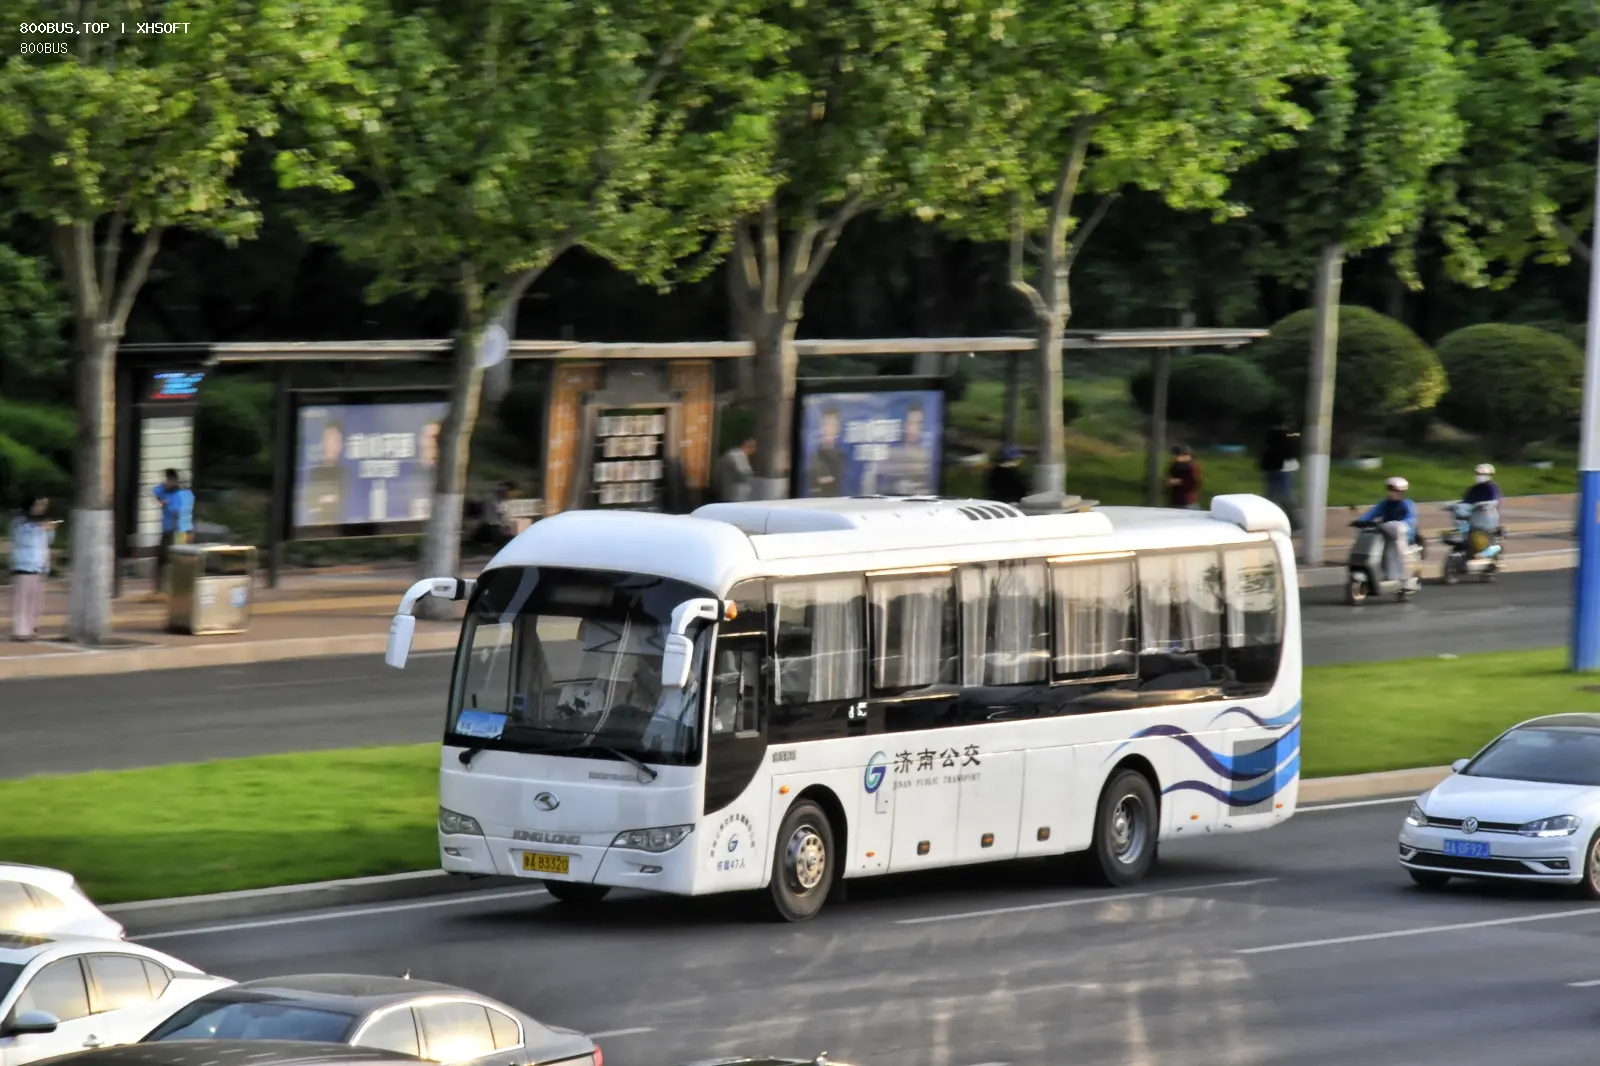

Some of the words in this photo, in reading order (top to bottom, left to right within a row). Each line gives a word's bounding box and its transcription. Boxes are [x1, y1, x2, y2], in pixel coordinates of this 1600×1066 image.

[894, 744, 981, 774] 济南公交
[916, 777, 939, 787] PUBLIC
[943, 772, 981, 784] TRANSPORT
[513, 829, 543, 843] KING
[544, 832, 582, 845] LONG
